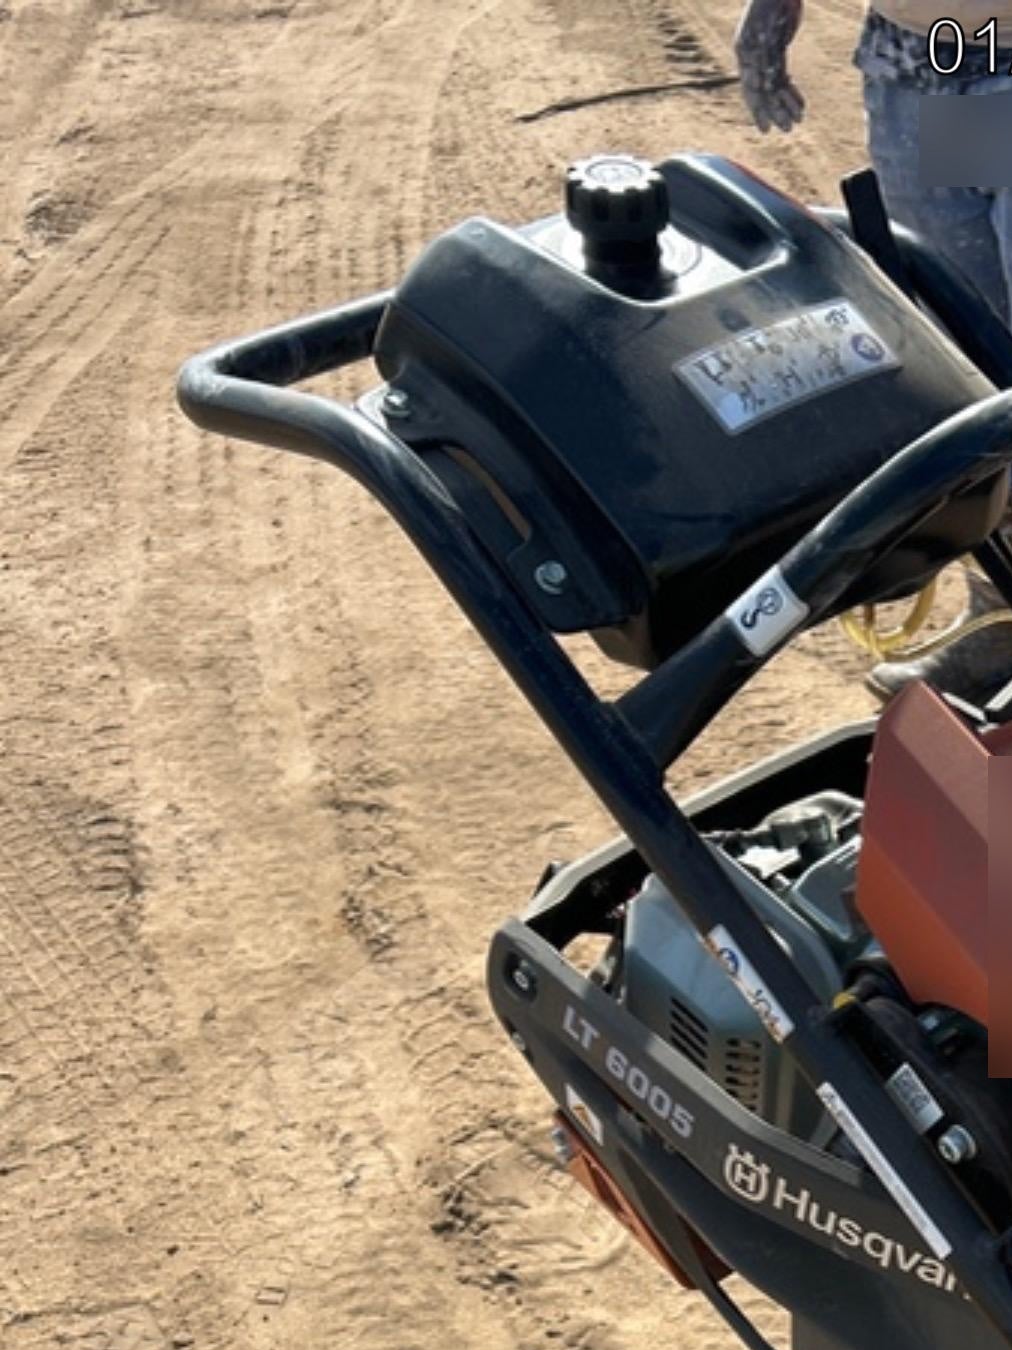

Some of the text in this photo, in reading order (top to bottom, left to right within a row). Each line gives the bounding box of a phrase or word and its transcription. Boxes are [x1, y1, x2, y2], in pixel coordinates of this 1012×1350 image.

[562, 1005, 695, 1138] LT 6005
[773, 1177, 972, 1301] Husqvar
